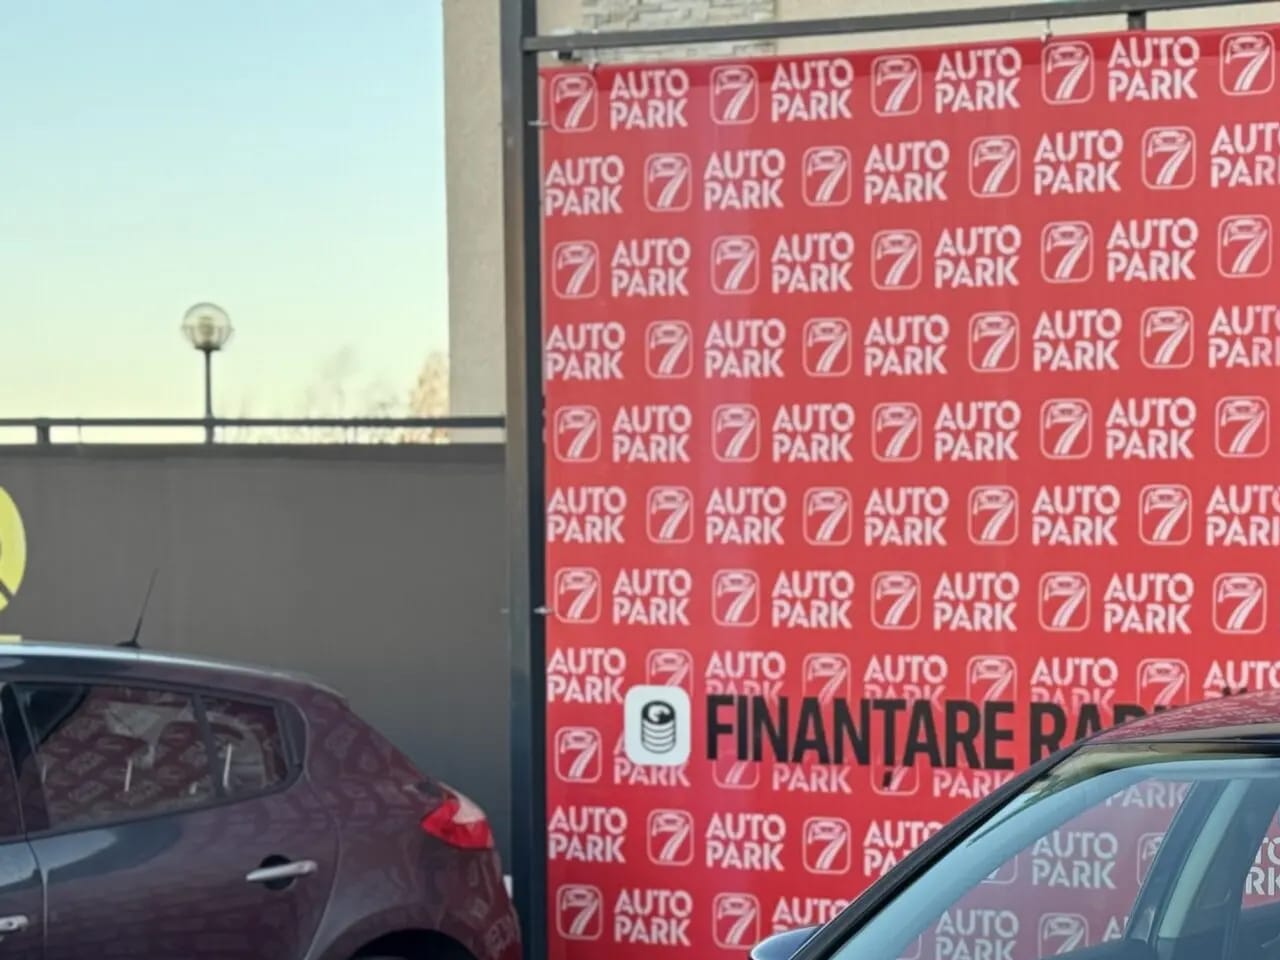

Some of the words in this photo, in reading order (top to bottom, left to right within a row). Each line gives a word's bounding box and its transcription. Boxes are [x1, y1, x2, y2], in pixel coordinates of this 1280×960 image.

[934, 47, 1021, 81] AUTO
[1107, 36, 1200, 70] AUTO
[609, 69, 689, 99] AUTO
[770, 58, 853, 91] AUTO
[1108, 68, 1198, 101] PARK
[772, 90, 851, 122] PARK
[935, 79, 1019, 113] PARK
[609, 97, 688, 129] PARK
[864, 140, 949, 173] AUTO
[1034, 129, 1123, 162] AUTO
[545, 156, 624, 188] AUTO
[704, 149, 785, 180] AUTO
[1035, 161, 1120, 195] PARK
[545, 184, 621, 216] PARK
[705, 179, 783, 210] PARK
[865, 171, 947, 204] PARK
[772, 232, 854, 263] AUTO
[935, 225, 1021, 257] AUTO
[1107, 218, 1198, 249] AUTO
[612, 238, 690, 267] AUTO
[1108, 250, 1195, 281] PARK
[612, 267, 688, 296] PARK
[772, 262, 852, 293] PARK
[935, 256, 1018, 288] PARK
[545, 322, 625, 352] AUTO
[705, 319, 786, 348] AUTO
[864, 314, 949, 345] AUTO
[1033, 308, 1121, 340] AUTO
[545, 350, 622, 381] PARK
[706, 349, 783, 378] PARK
[865, 344, 946, 376] PARK
[1034, 340, 1119, 371] PARK
[613, 405, 691, 433] AUTO
[773, 403, 854, 432] AUTO
[935, 400, 1020, 430] AUTO
[1106, 397, 1196, 427] AUTO
[613, 434, 689, 462] PARK
[773, 433, 852, 462] PARK
[935, 431, 1018, 461] PARK
[1106, 429, 1193, 459] PARK
[546, 487, 626, 516] AUTO
[706, 487, 786, 515] AUTO
[865, 487, 949, 516] AUTO
[1032, 485, 1120, 515] AUTO
[546, 514, 624, 544] PARK
[706, 516, 784, 544] PARK
[865, 516, 946, 545] PARK
[1032, 516, 1117, 545] PARK
[613, 569, 691, 597] AUTO
[772, 571, 854, 600] AUTO
[934, 572, 1019, 601] AUTO
[1104, 573, 1194, 603] AUTO
[613, 597, 689, 625] PARK
[772, 599, 852, 629] PARK
[934, 601, 1016, 631] PARK
[1104, 603, 1191, 634] PARK
[546, 648, 626, 677] AUTO
[706, 651, 786, 680] AUTO
[864, 655, 948, 684] AUTO
[1031, 657, 1119, 687] AUTO
[547, 675, 625, 705] PARK
[772, 764, 852, 793] PARK
[548, 806, 627, 835] AUTO
[706, 813, 786, 842] AUTO
[548, 833, 625, 863] PARK
[706, 840, 784, 871] PARK
[1031, 832, 1118, 861] AUTO
[1032, 859, 1117, 889] PARK
[615, 889, 692, 918] AUTO
[615, 916, 691, 946] PARK
[935, 909, 1019, 939] AUTO
